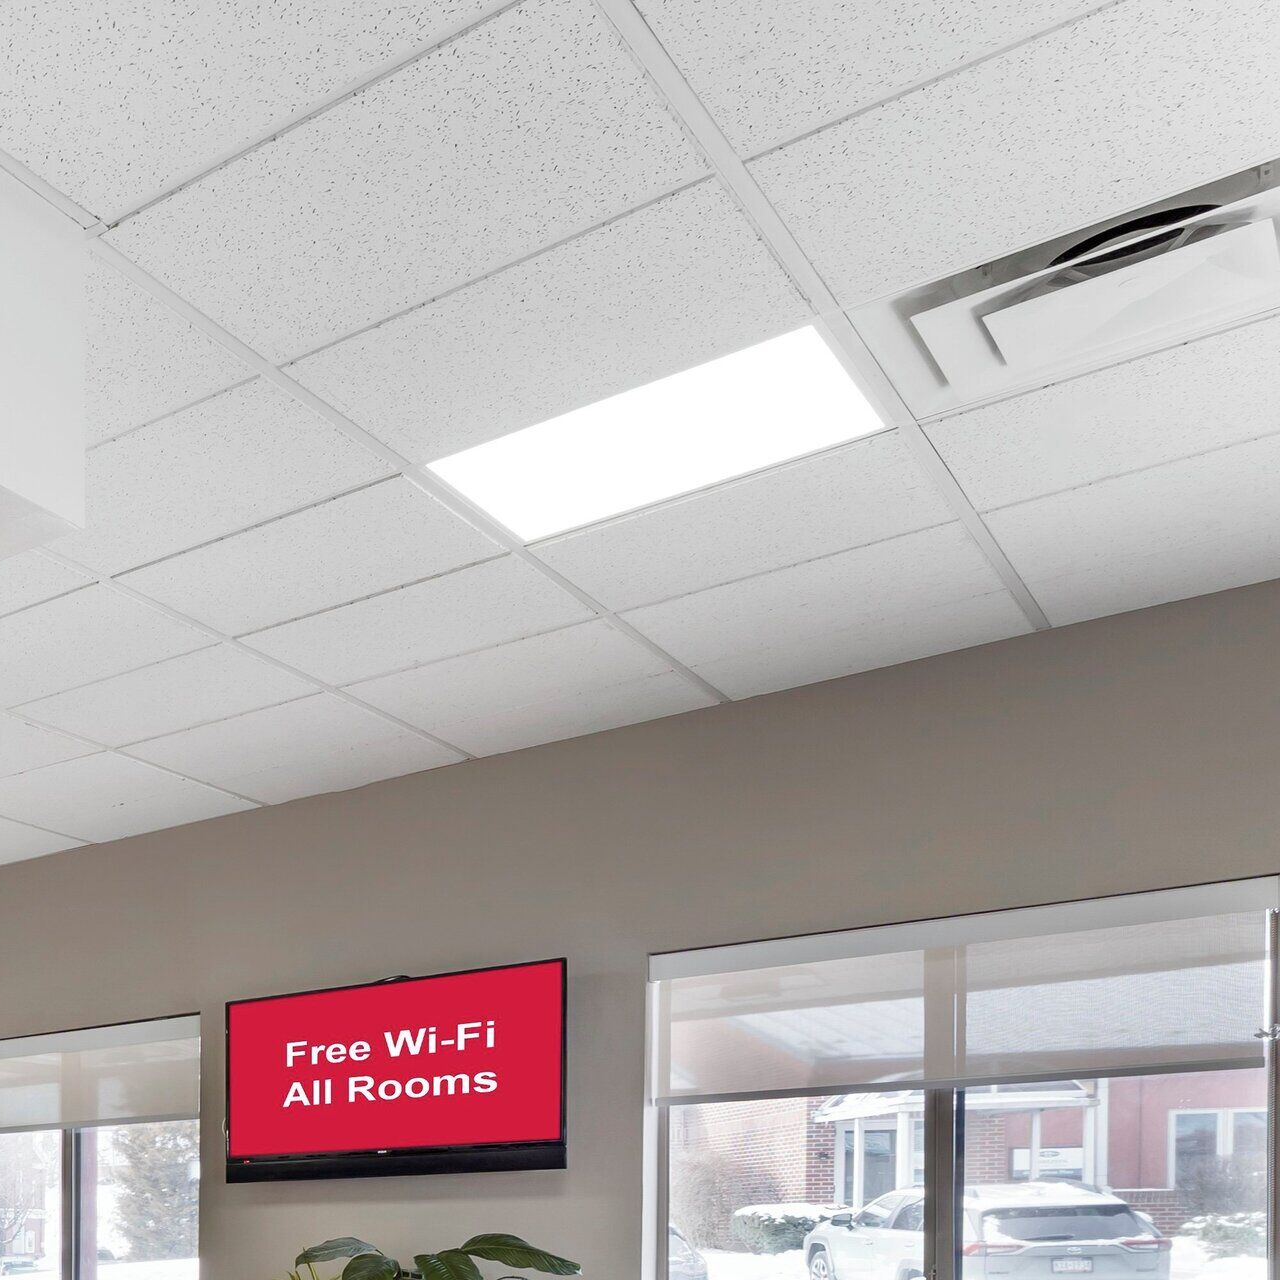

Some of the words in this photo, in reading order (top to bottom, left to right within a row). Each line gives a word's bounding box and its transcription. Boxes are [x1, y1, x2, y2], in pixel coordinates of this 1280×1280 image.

[286, 1040, 371, 1067] Free
[384, 1020, 495, 1058] Wi-Fi
[282, 1080, 332, 1108] All
[348, 1070, 498, 1103] Rooms
